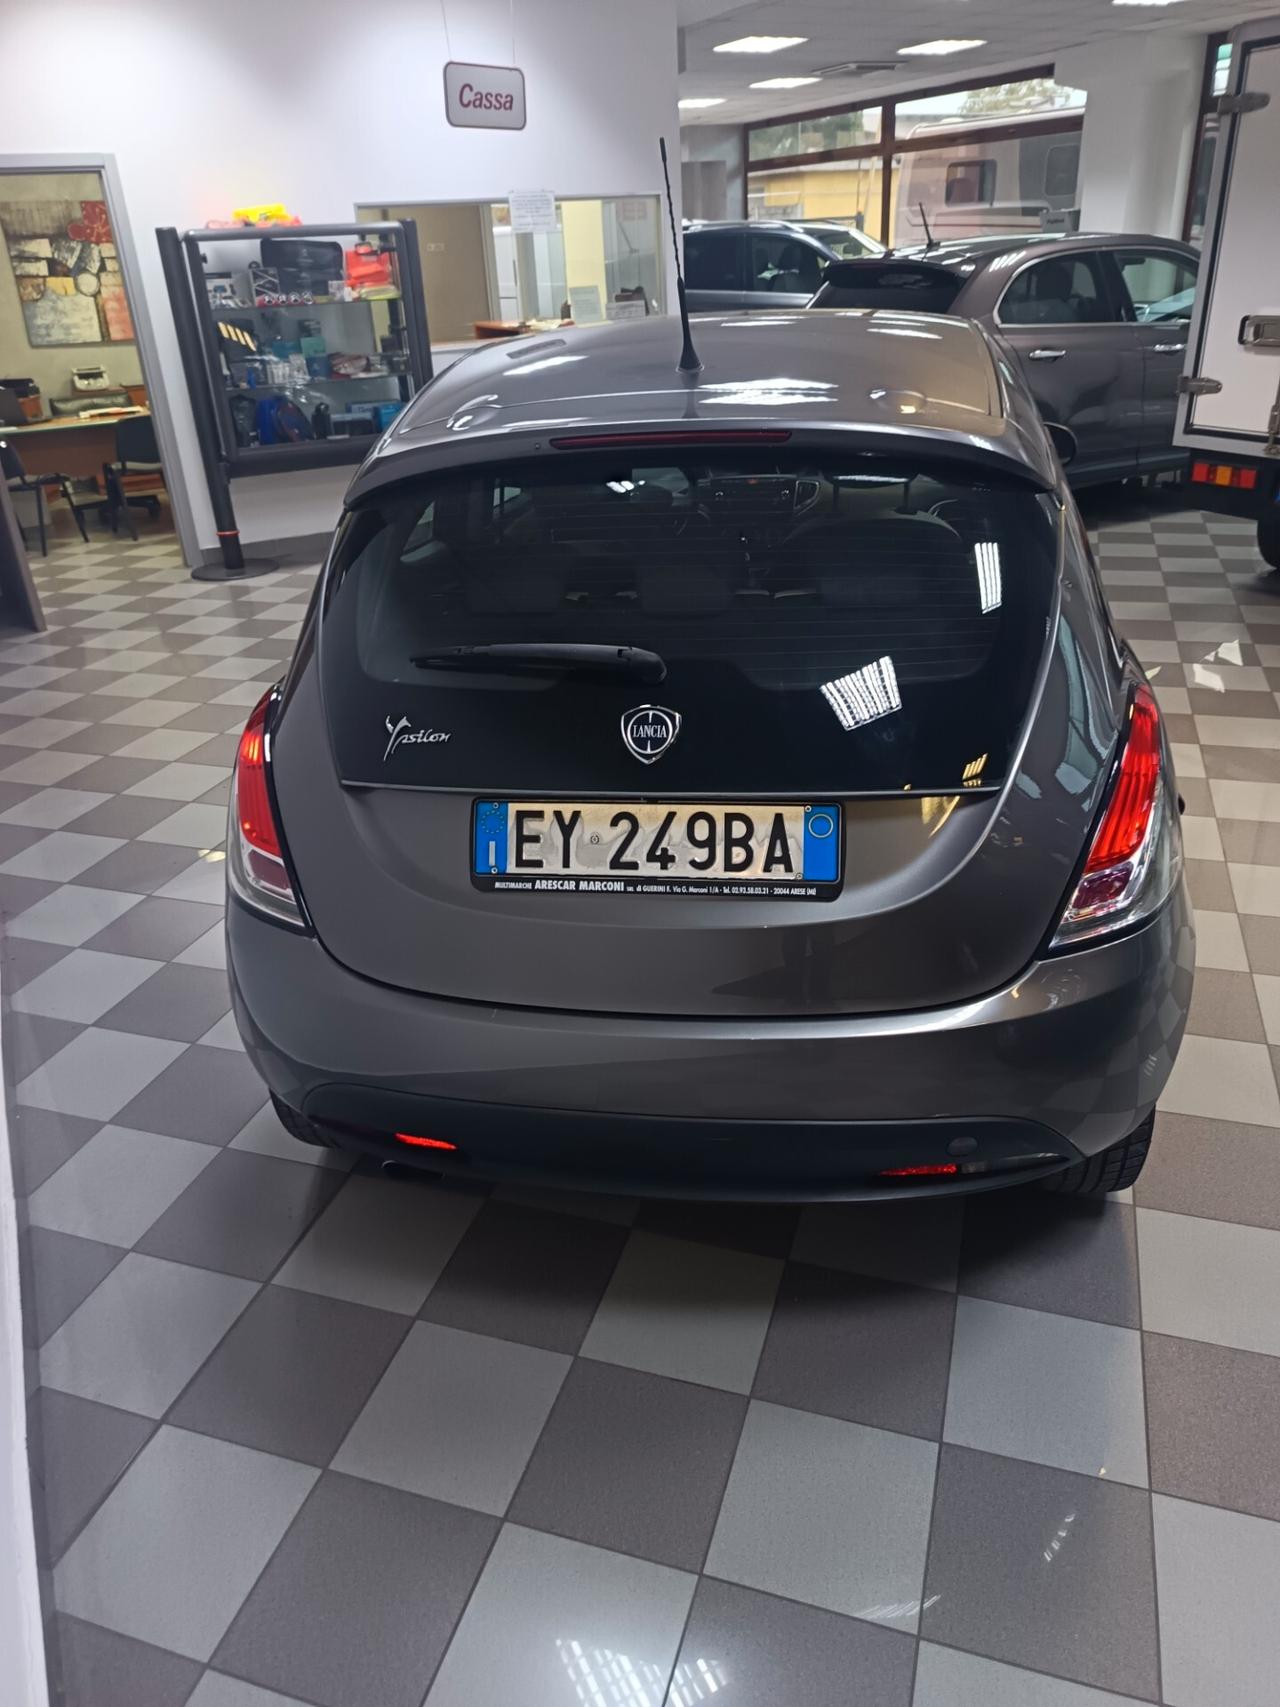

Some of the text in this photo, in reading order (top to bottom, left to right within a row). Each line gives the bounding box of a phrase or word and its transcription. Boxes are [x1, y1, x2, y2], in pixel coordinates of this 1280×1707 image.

[458, 83, 514, 111] Cassa
[383, 715, 452, 762] Ypsilon
[632, 724, 667, 738] LANCIA
[514, 809, 794, 873] EY 249BA
[494, 881, 533, 890] MULTIMARCHE
[534, 879, 576, 890] ARESCAR
[579, 880, 625, 892] MARCONI
[642, 885, 665, 893] GUERINI
[689, 886, 708, 894] Marconi
[790, 888, 806, 896] ARESE
